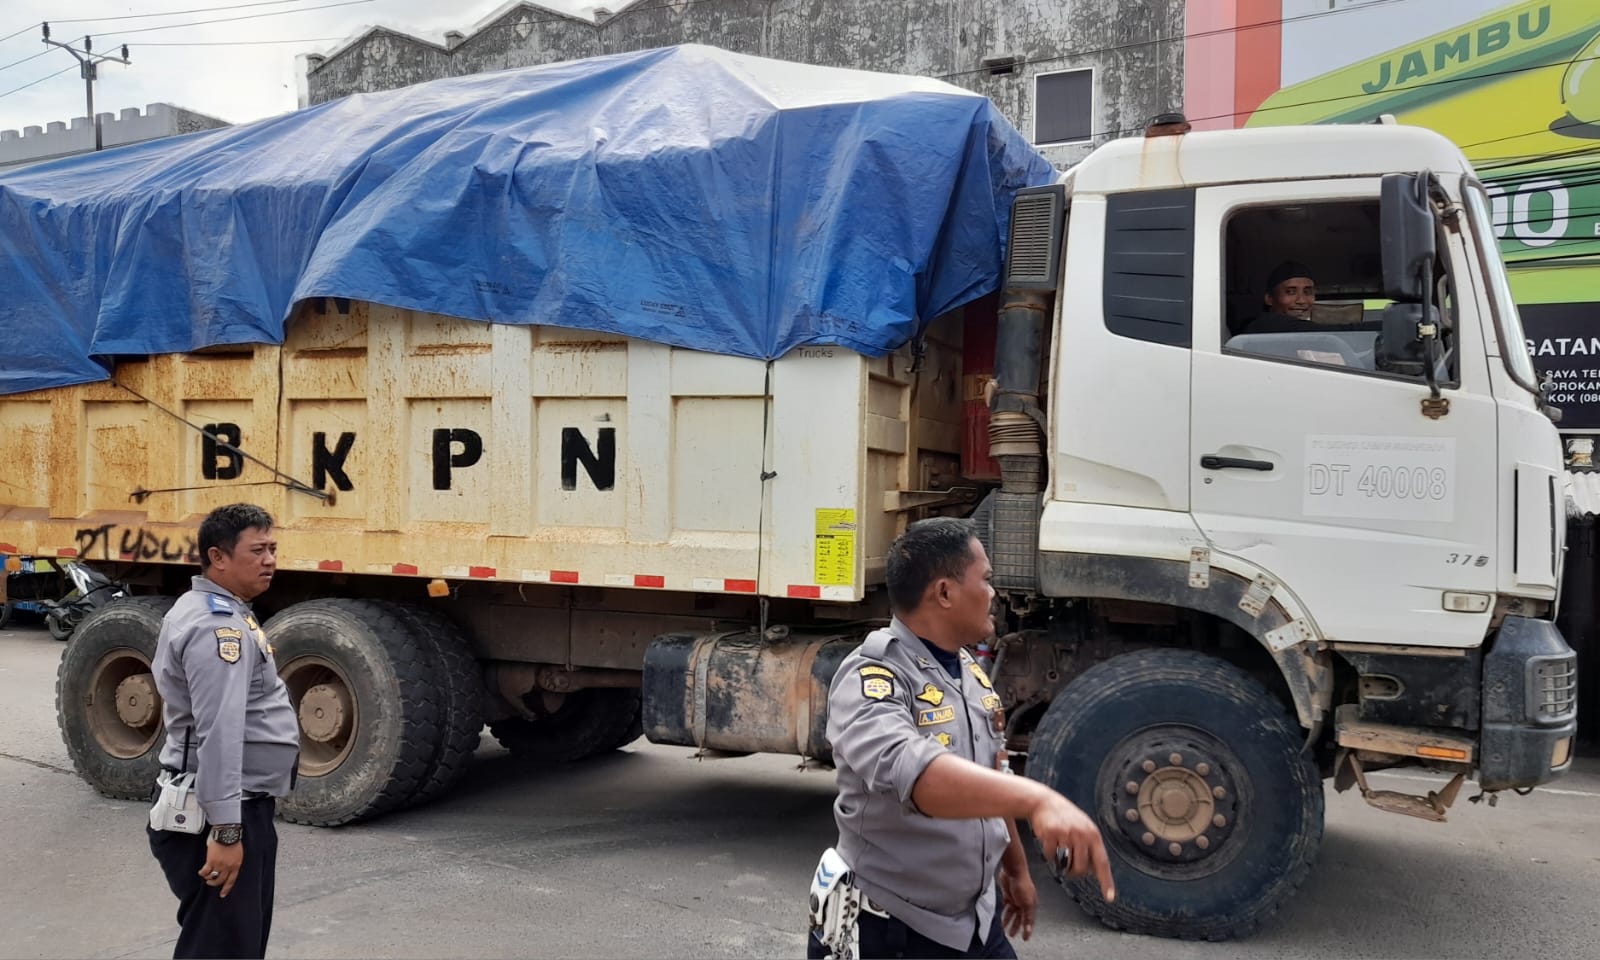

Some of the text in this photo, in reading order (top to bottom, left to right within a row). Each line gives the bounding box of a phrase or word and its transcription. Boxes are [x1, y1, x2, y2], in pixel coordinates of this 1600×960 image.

[1361, 5, 1551, 94] JAMBU
[797, 347, 833, 358] Trucks
[1545, 369, 1600, 379] SAYA TE
[1580, 393, 1600, 405] (08
[1307, 463, 1447, 500] DT 40008
